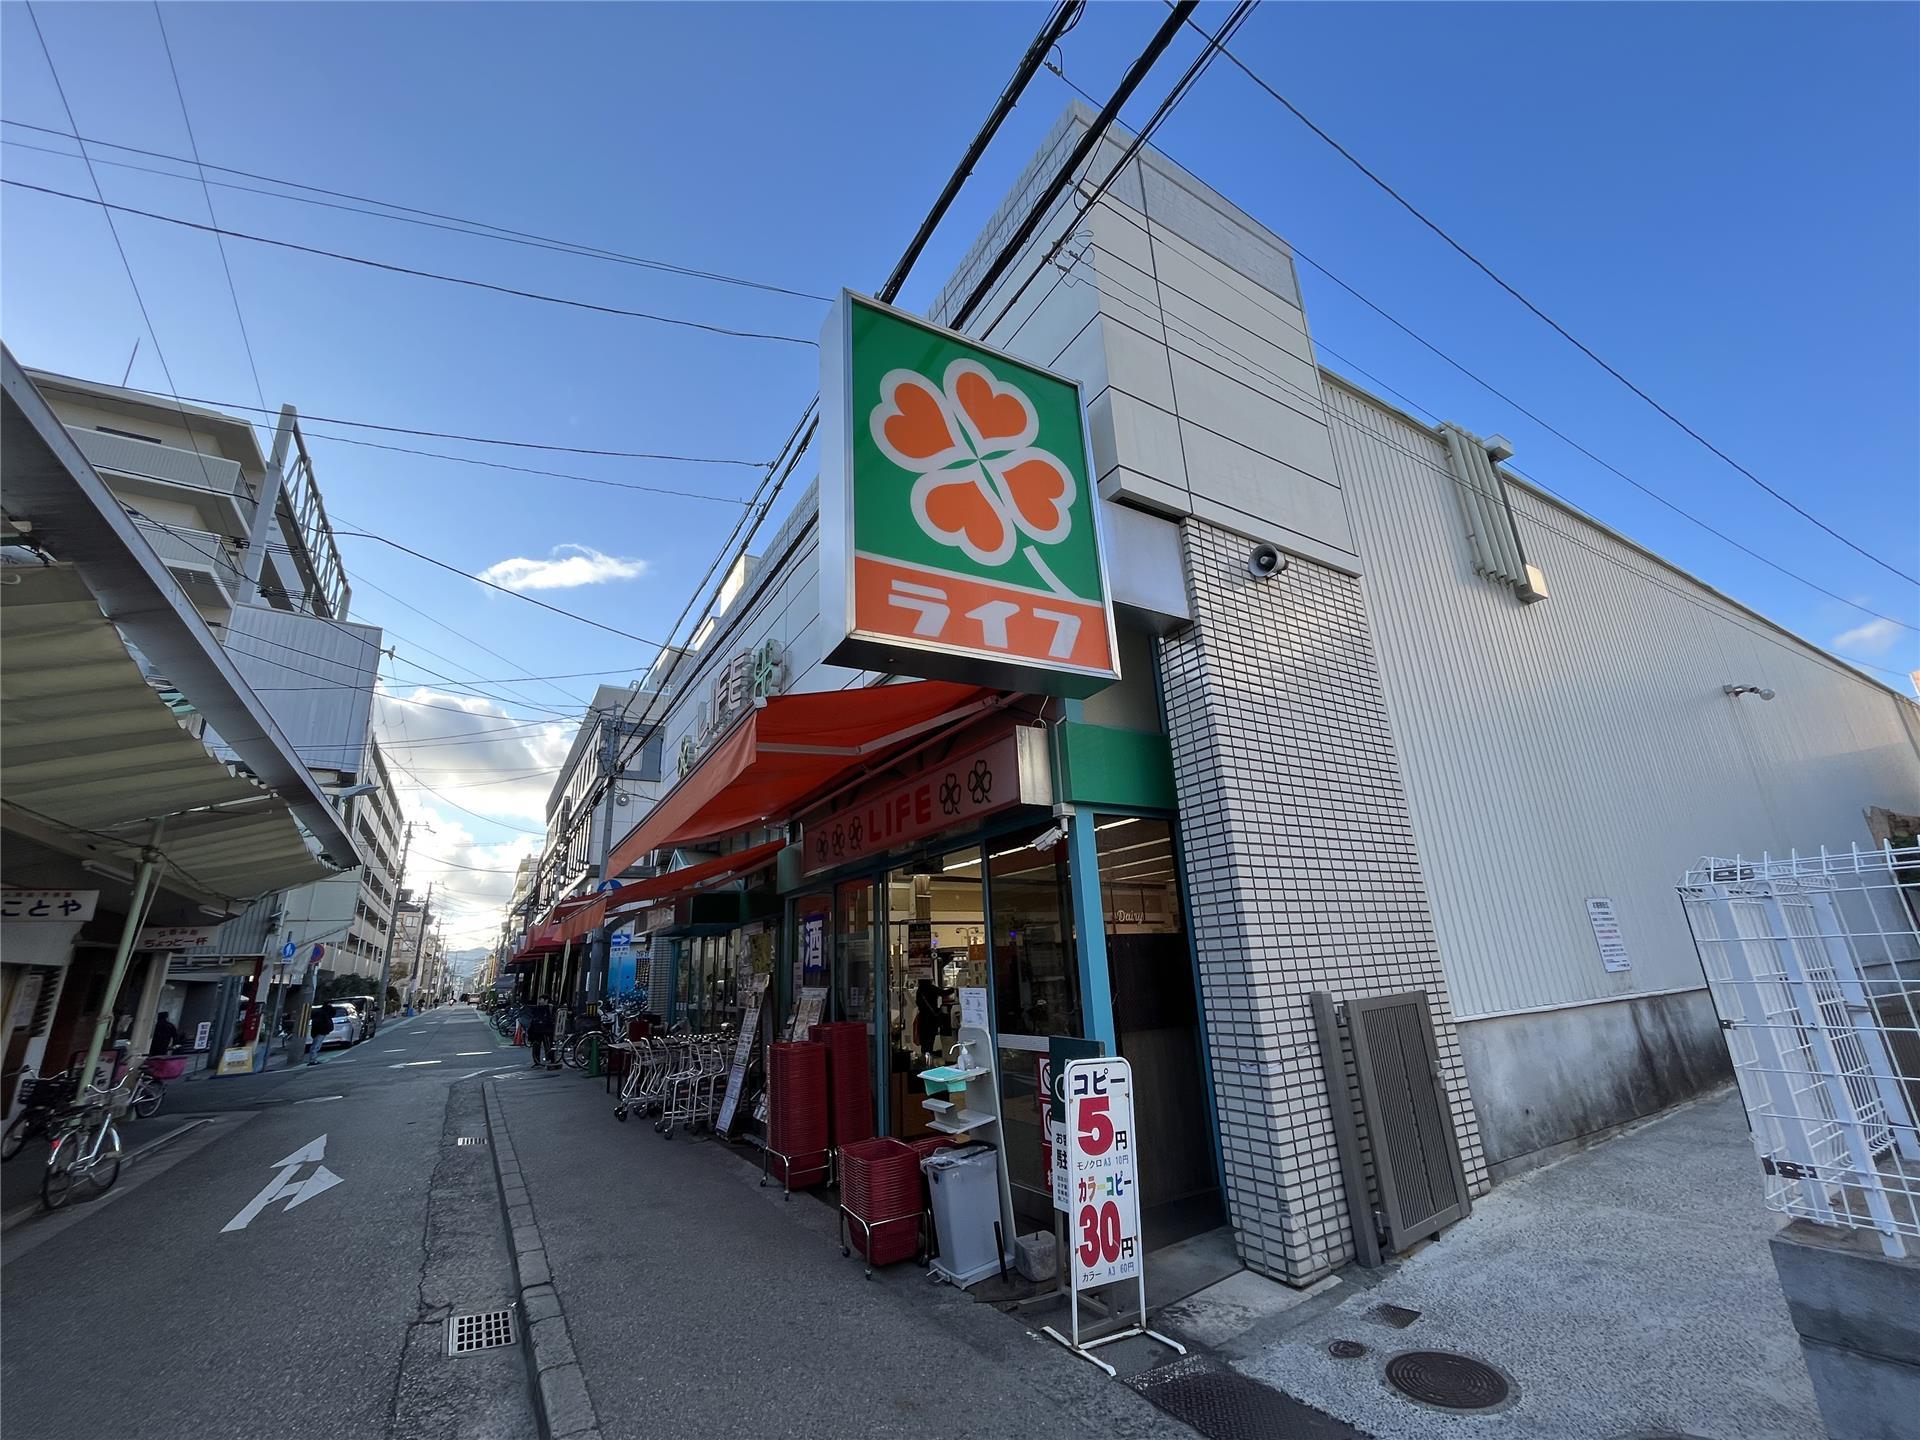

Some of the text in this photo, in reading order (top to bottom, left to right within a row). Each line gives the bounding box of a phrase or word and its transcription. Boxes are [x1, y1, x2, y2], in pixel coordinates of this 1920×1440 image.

[888, 579, 1082, 659] ライフ
[868, 784, 932, 842] LIFE
[1115, 909, 1143, 927] Dairy
[805, 919, 823, 968] 酒
[1074, 1068, 1125, 1095] コピー
[1078, 1096, 1128, 1156] 5円
[1077, 1154, 1129, 1170] モノクロ A3 10円
[1078, 1170, 1132, 1204] カラーコピー
[1079, 1200, 1134, 1268] 30円
[1082, 1261, 1135, 1283] カラー A3 60円
